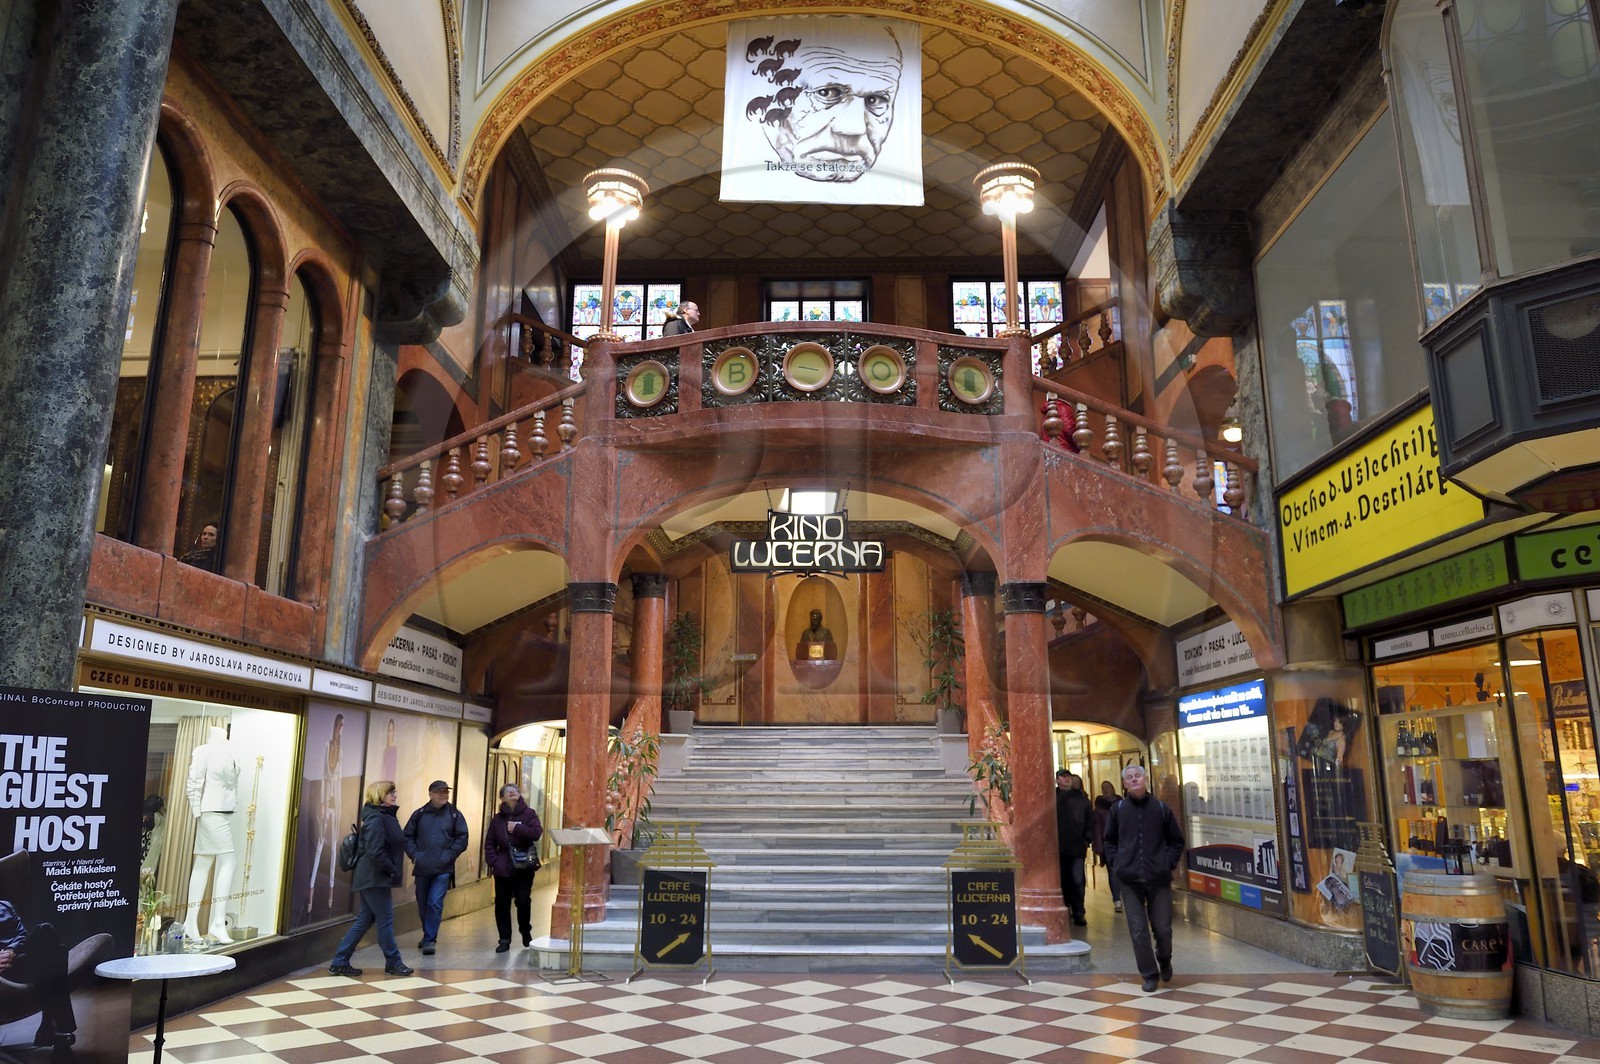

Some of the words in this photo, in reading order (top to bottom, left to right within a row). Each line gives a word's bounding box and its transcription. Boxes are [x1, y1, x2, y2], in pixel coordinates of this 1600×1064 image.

[764, 160, 796, 172] Takže
[800, 163, 813, 172] se
[729, 362, 746, 384] B
[769, 514, 844, 541] KINO
[733, 541, 884, 568] LUCERNA
[1551, 533, 1600, 569] ce
[1208, 635, 1225, 653] PASÁŽ
[108, 633, 167, 656] DESIGNED
[172, 647, 185, 659] BY
[189, 650, 243, 672] JAROSLAVA
[246, 662, 303, 684] PROCHÁZKOVÁ
[422, 645, 438, 660] PASÁŽ
[90, 669, 129, 686] CZECH
[134, 678, 174, 693] DESIGN
[178, 683, 202, 696] WITH
[205, 688, 270, 706] INTERNATIONAL
[378, 690, 402, 702] DESIGNED
[32, 696, 84, 707] BoConcept
[88, 700, 146, 712] PRODUCTION
[0, 734, 68, 772] THE
[0, 772, 109, 809] GUEST
[13, 815, 106, 853] HOST
[42, 860, 66, 868] starring
[46, 867, 72, 876] Mads
[73, 864, 116, 875] Mikkelsen
[1196, 856, 1232, 872] www.rak.cz
[50, 881, 82, 892] Čekáte
[84, 879, 114, 891] hosty?
[659, 881, 690, 891] CAFE
[968, 881, 1000, 891] CAFE
[54, 890, 104, 902] Potřebujete
[106, 890, 120, 898] ten
[648, 892, 701, 903] LUCERNA
[957, 892, 1011, 903] LUCERNA
[57, 901, 92, 912] správný
[93, 898, 130, 909] nábytek.
[650, 914, 667, 926] 10
[680, 914, 698, 926] 24
[960, 914, 978, 926] 10
[991, 914, 1009, 926] 24
